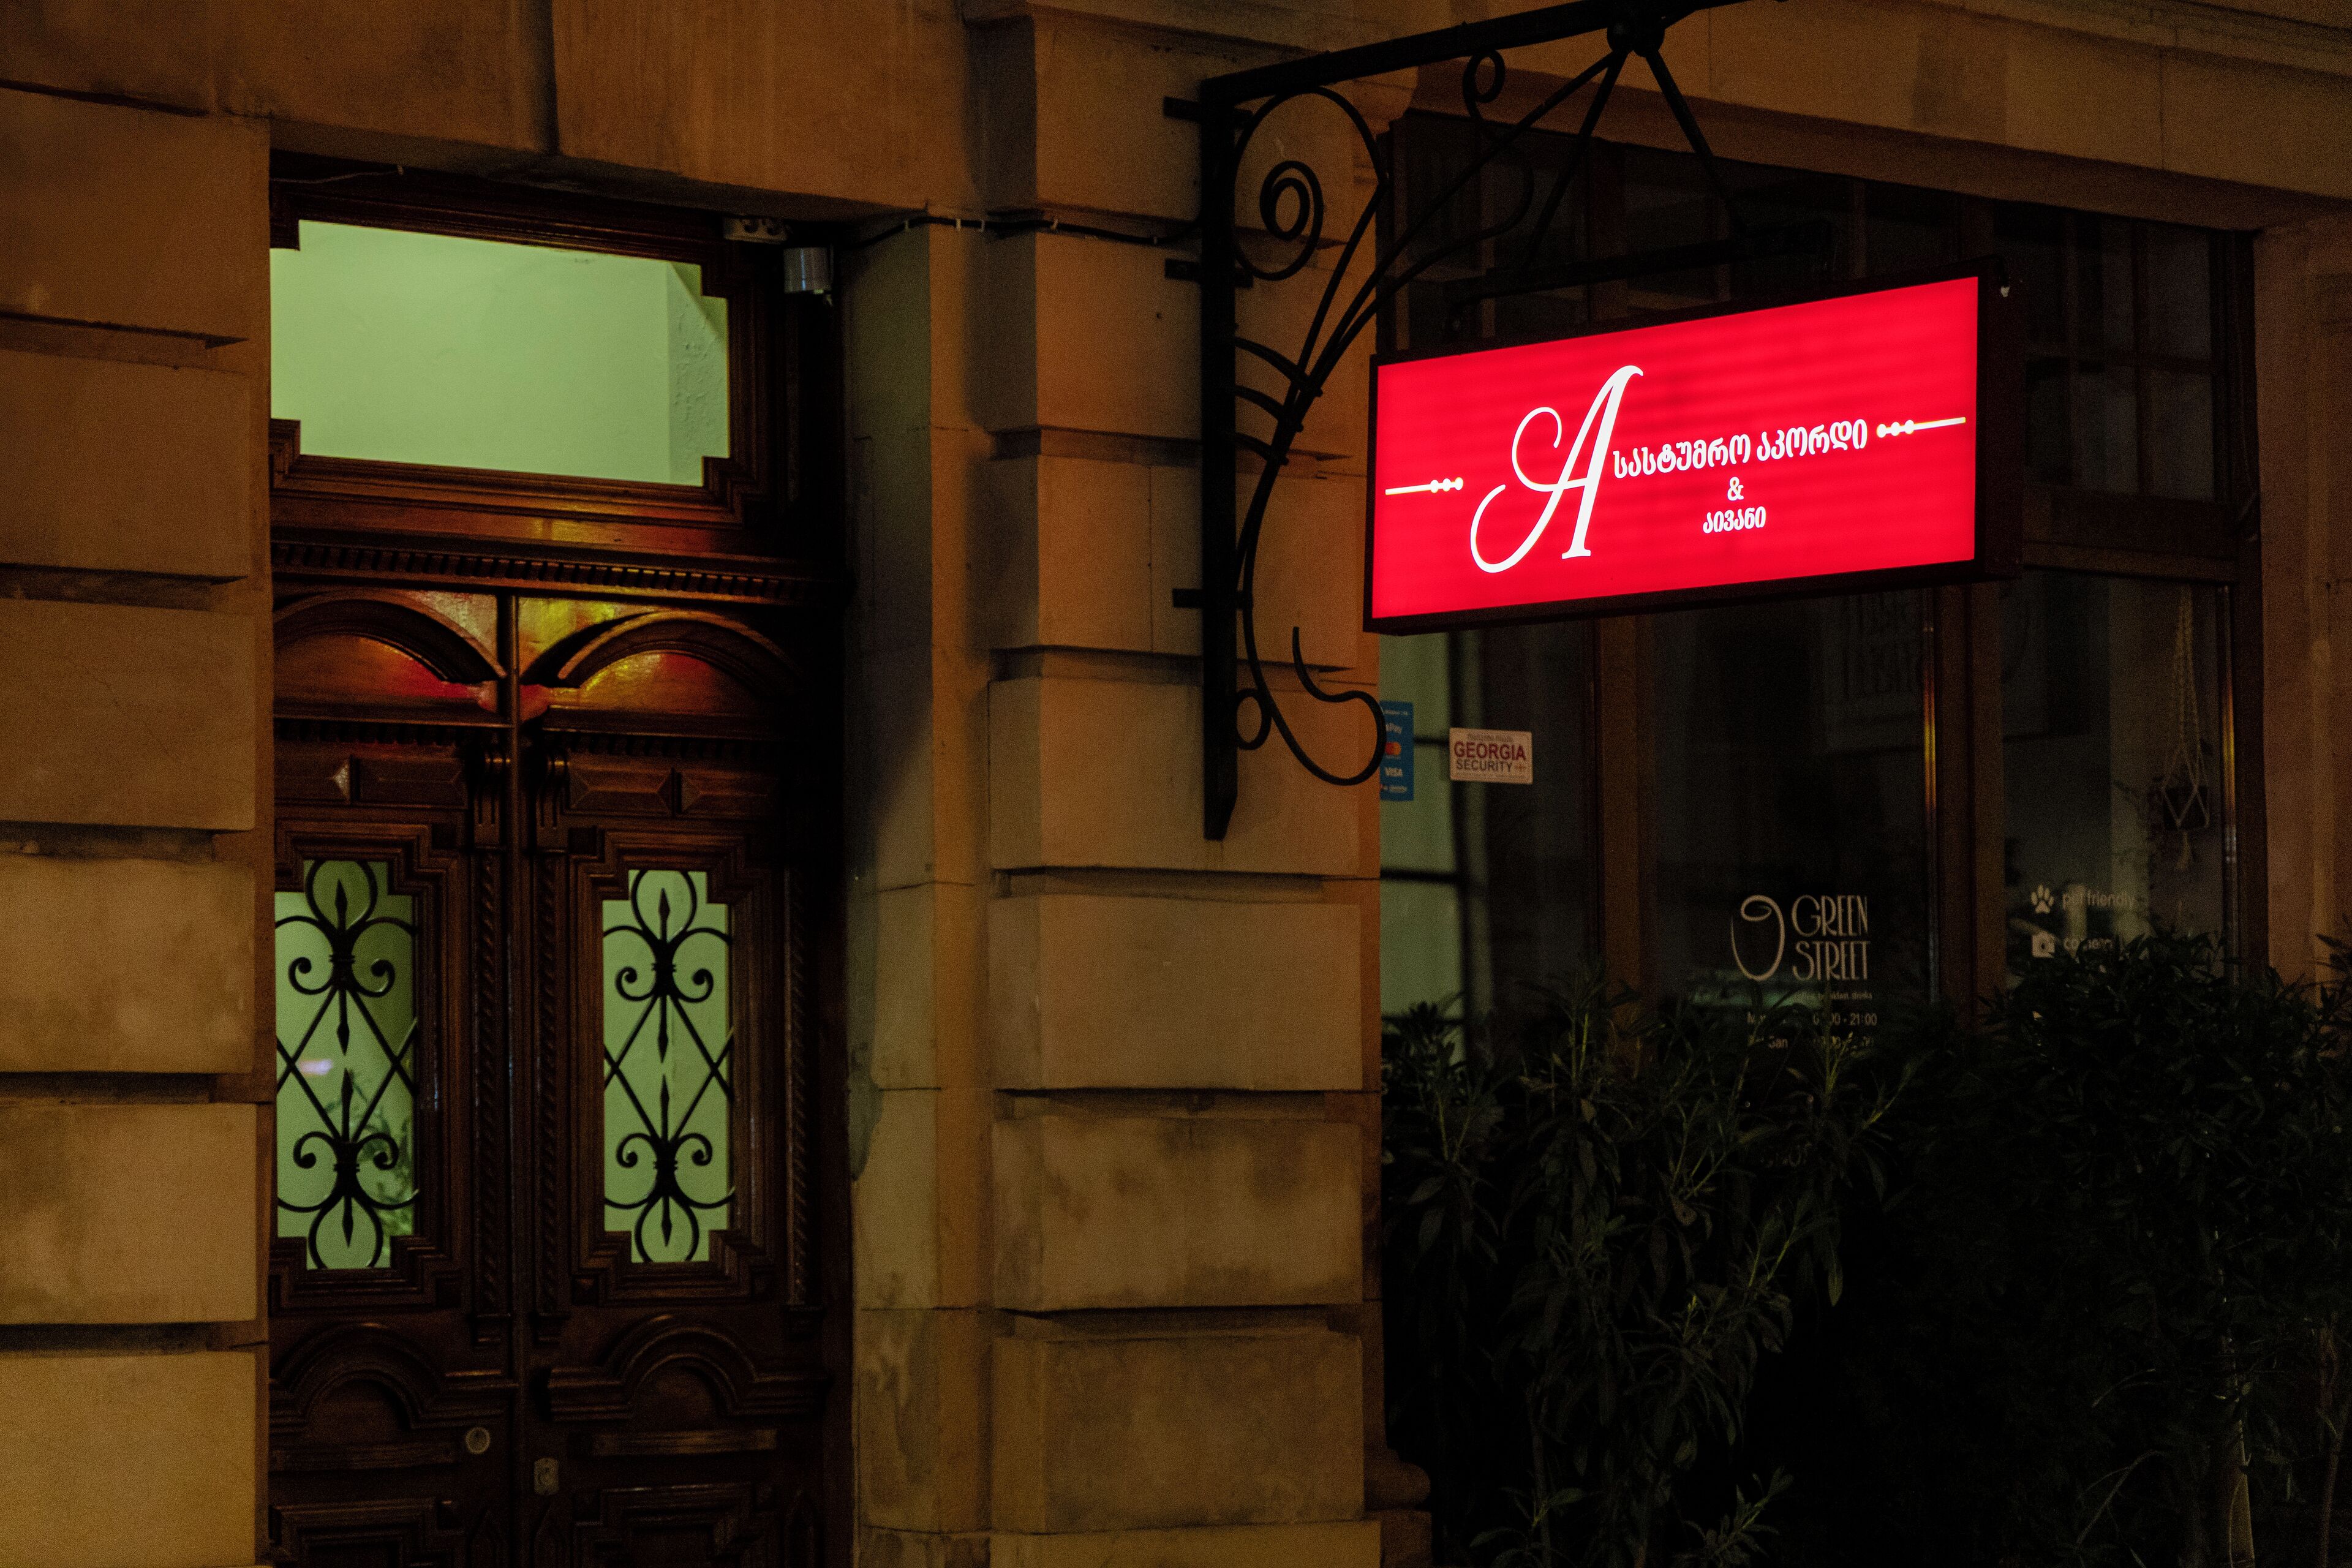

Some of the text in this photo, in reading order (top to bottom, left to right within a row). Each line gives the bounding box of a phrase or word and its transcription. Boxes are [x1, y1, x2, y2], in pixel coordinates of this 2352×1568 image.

[1613, 418, 1868, 479] სასტუმრო აკორდი
[1470, 365, 1644, 573] A
[1727, 476, 1744, 501] &
[1702, 505, 1766, 534] აივანი
[1453, 741, 1526, 761] GEORGIA
[1456, 759, 1512, 772] SECURITY
[1791, 894, 1868, 937] GREEN
[2087, 891, 2136, 911] friendly
[1792, 940, 1871, 981] STREET
